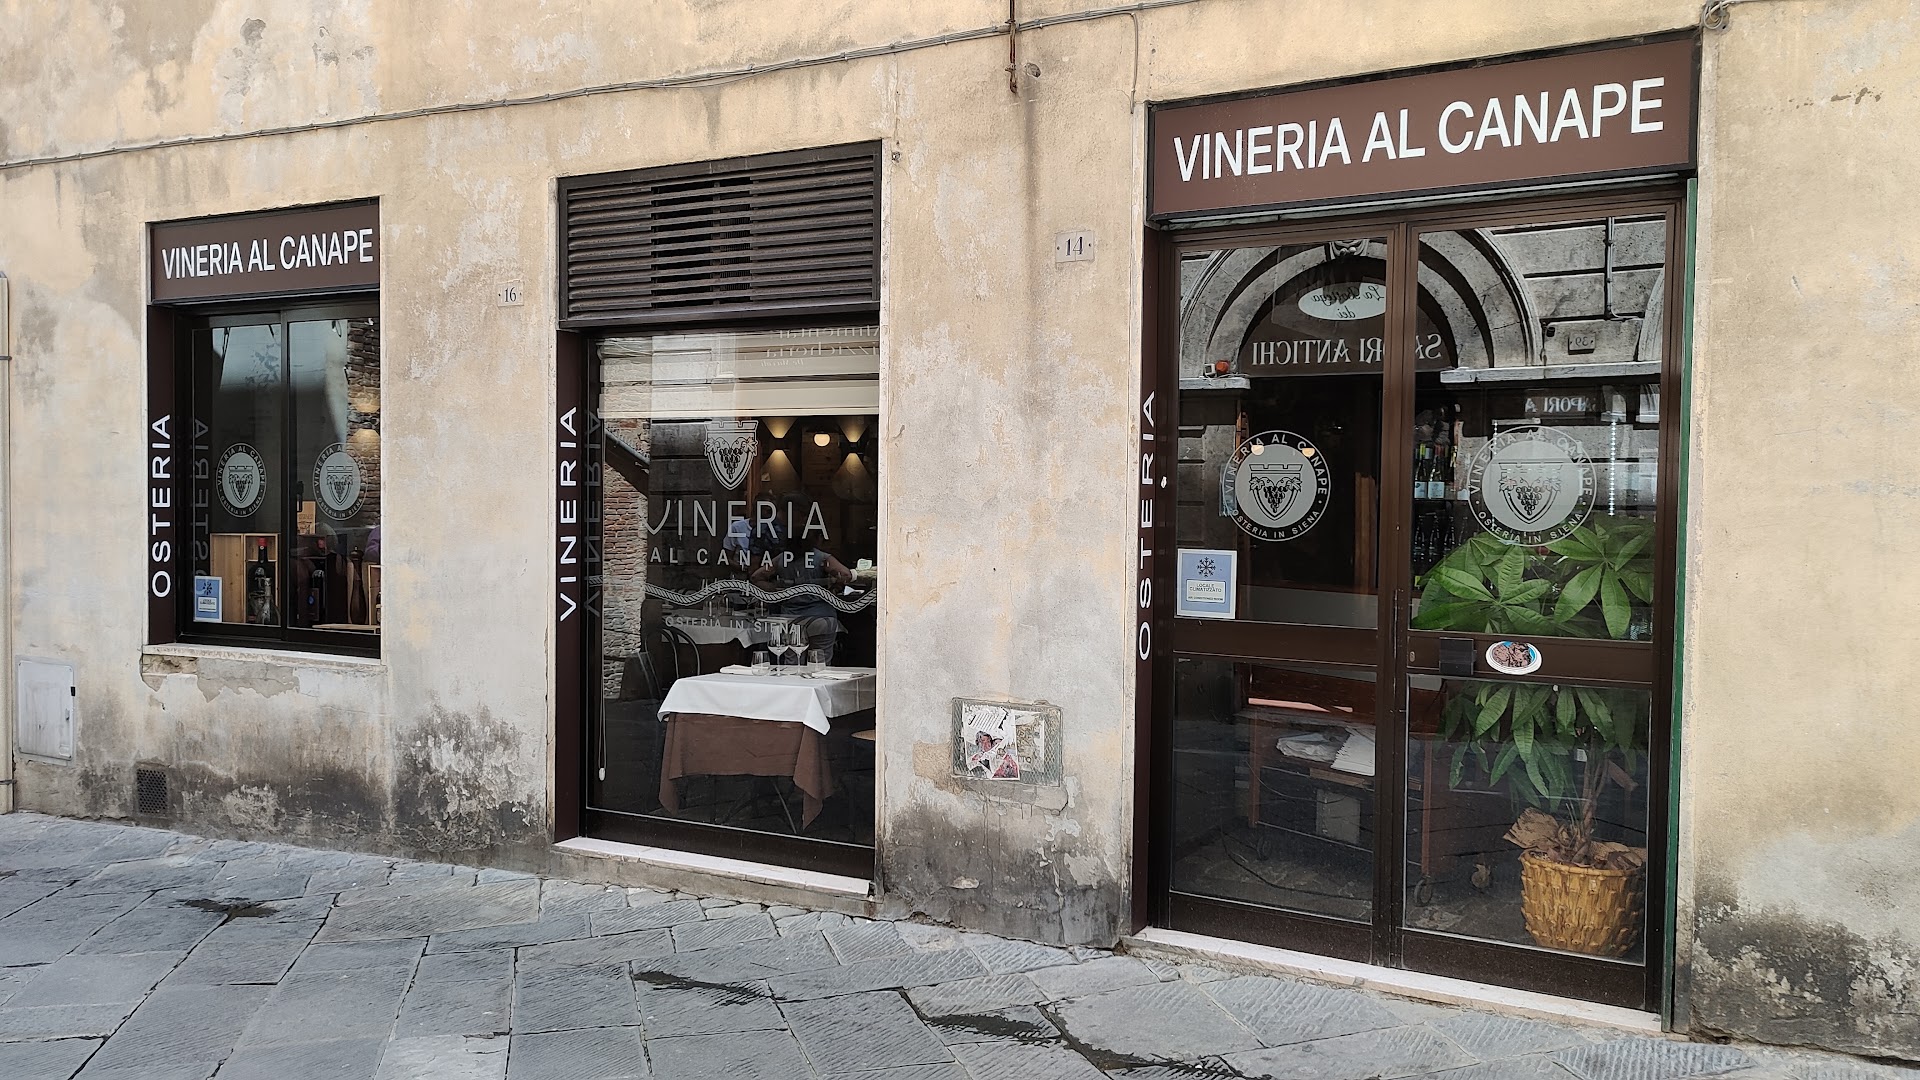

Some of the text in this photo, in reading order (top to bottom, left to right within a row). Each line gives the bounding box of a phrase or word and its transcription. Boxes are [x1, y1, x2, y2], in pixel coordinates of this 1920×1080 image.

[1173, 77, 1665, 182] VINERIA AL CANAPE
[161, 228, 374, 280] VINERIA AL CANAPE
[217, 448, 236, 486] VINERIA
[238, 445, 247, 454] AL
[314, 448, 334, 487] VINERIA
[1225, 433, 1327, 495] VINERIA AL CNAPE
[1470, 433, 1517, 494] VINERIA
[151, 414, 171, 598] OSTERIA
[560, 406, 577, 622] VINERIA
[640, 500, 830, 540] VINERIA
[1138, 391, 1155, 661] OSTERIA
[1231, 509, 1320, 539] OSTERIA IN SIENA
[1478, 511, 1583, 543] OSTERIA IN SIENA
[650, 547, 815, 569] AL CANAPE
[665, 616, 798, 635] OSTERIA IN SIENA
